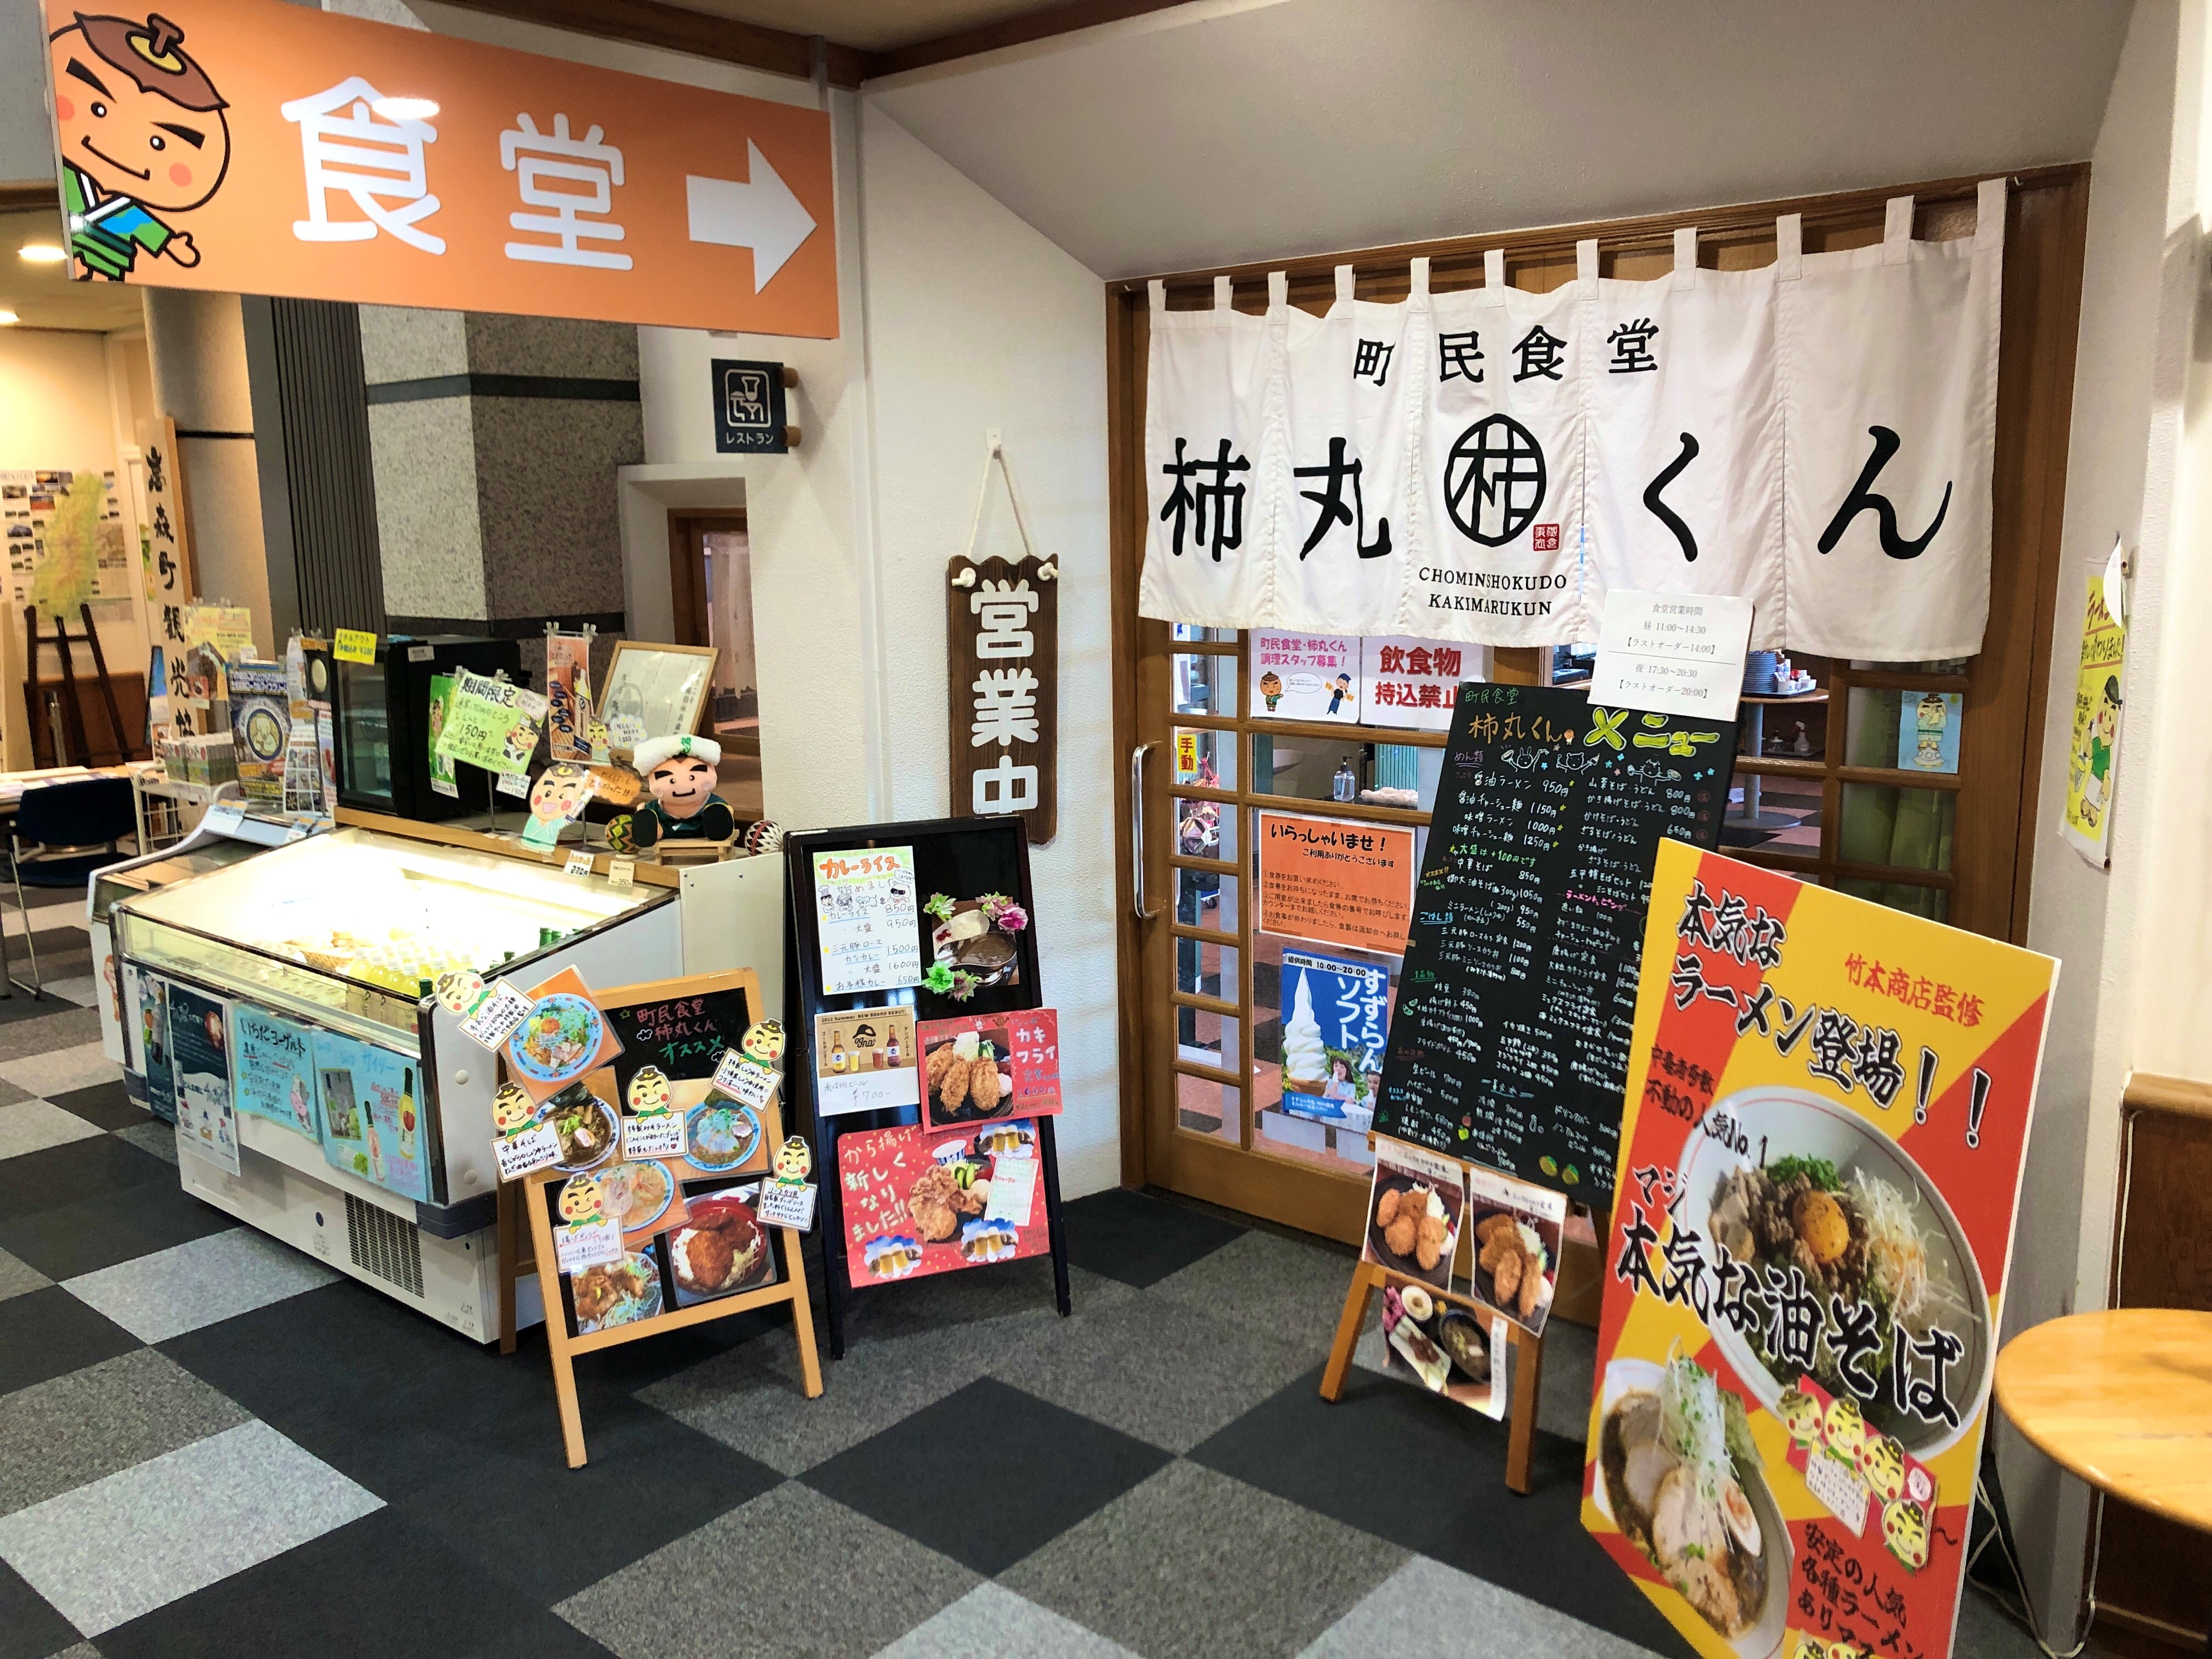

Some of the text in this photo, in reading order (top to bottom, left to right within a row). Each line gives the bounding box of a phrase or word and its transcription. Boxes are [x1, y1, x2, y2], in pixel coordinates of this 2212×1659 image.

[281, 75, 634, 271] 食堂
[1354, 318, 1658, 386] 町民食堂
[726, 432, 774, 445] レストラン
[1161, 426, 1953, 562] 柿丸くん
[1419, 567, 1567, 590] CHOMINSHOKUDO
[1429, 594, 1551, 617] KAKIMARUKUN
[1652, 603, 1703, 616] 食堂営業時間
[1643, 621, 1651, 630] 昼
[1261, 637, 1347, 652] 町民食堂・柿丸くん
[1628, 637, 1716, 654] 【ラストオーダー14:00】
[1261, 653, 1345, 667] 調理スタッフ募集！
[1380, 645, 1461, 676] 飲食物
[1635, 664, 1643, 673] 夜
[460, 676, 516, 708] 期間限定
[970, 579, 1039, 814] 営業中
[1375, 682, 1457, 709] 持込禁止
[1465, 689, 1519, 704] 町民食堂
[1620, 680, 1708, 698] 【ラストオーダー20:00】
[460, 723, 487, 742] 150円
[1469, 713, 1562, 744] 柿丸くん
[1583, 707, 1720, 757] メニュー
[1181, 737, 1193, 771] 手動
[1454, 750, 1483, 763] めん類
[1474, 771, 1568, 797] 醤油ラーメン 950円
[1666, 788, 1691, 803] 800円
[1530, 802, 1557, 818] 1150円
[1671, 805, 1696, 819] 800円
[1464, 811, 1556, 835] 味噌ラーメン 1000円
[1667, 824, 1692, 839] 650円
[1272, 824, 1385, 851] いらっしゃいませ！
[1453, 823, 1549, 851] 味噌チャーシュー麺 1250円
[820, 855, 900, 879] カレーライス
[1457, 857, 1493, 872] 中華そば
[1519, 871, 1541, 884] 850円
[837, 879, 894, 894] 始めました
[1520, 888, 1543, 904] 1050円
[829, 904, 915, 919] カレーライス 850円
[1520, 905, 1539, 919] 950円
[856, 919, 916, 933] 大盛 950円
[1516, 917, 1536, 933] 550円
[1678, 881, 1786, 970] 本気な
[832, 939, 918, 953] 三元豚ロース 1500円
[864, 961, 919, 973] 大盛 1600円
[1288, 956, 1312, 967] 提供時間
[836, 975, 919, 991] お子様カレー 650円
[1845, 952, 1985, 1026] 竹本商店監修
[637, 997, 706, 1026] 町民食堂
[1336, 977, 1360, 1049] ソフト
[1360, 969, 1387, 1073] すずらん
[654, 1019, 717, 1041] 柿丸くん
[1016, 1026, 1046, 1043] カキ
[659, 1035, 724, 1065] オススメ
[1017, 1046, 1056, 1064] フライ
[824, 1080, 868, 1092] 南信州ビール
[501, 1134, 537, 1154] 中華そば
[844, 1125, 917, 1165] から揚げ
[845, 1152, 906, 1191] 新しく
[860, 1184, 896, 1211] なり
[1634, 1165, 1689, 1215] マジ
[1616, 1201, 1965, 1427] 本気な油そば
